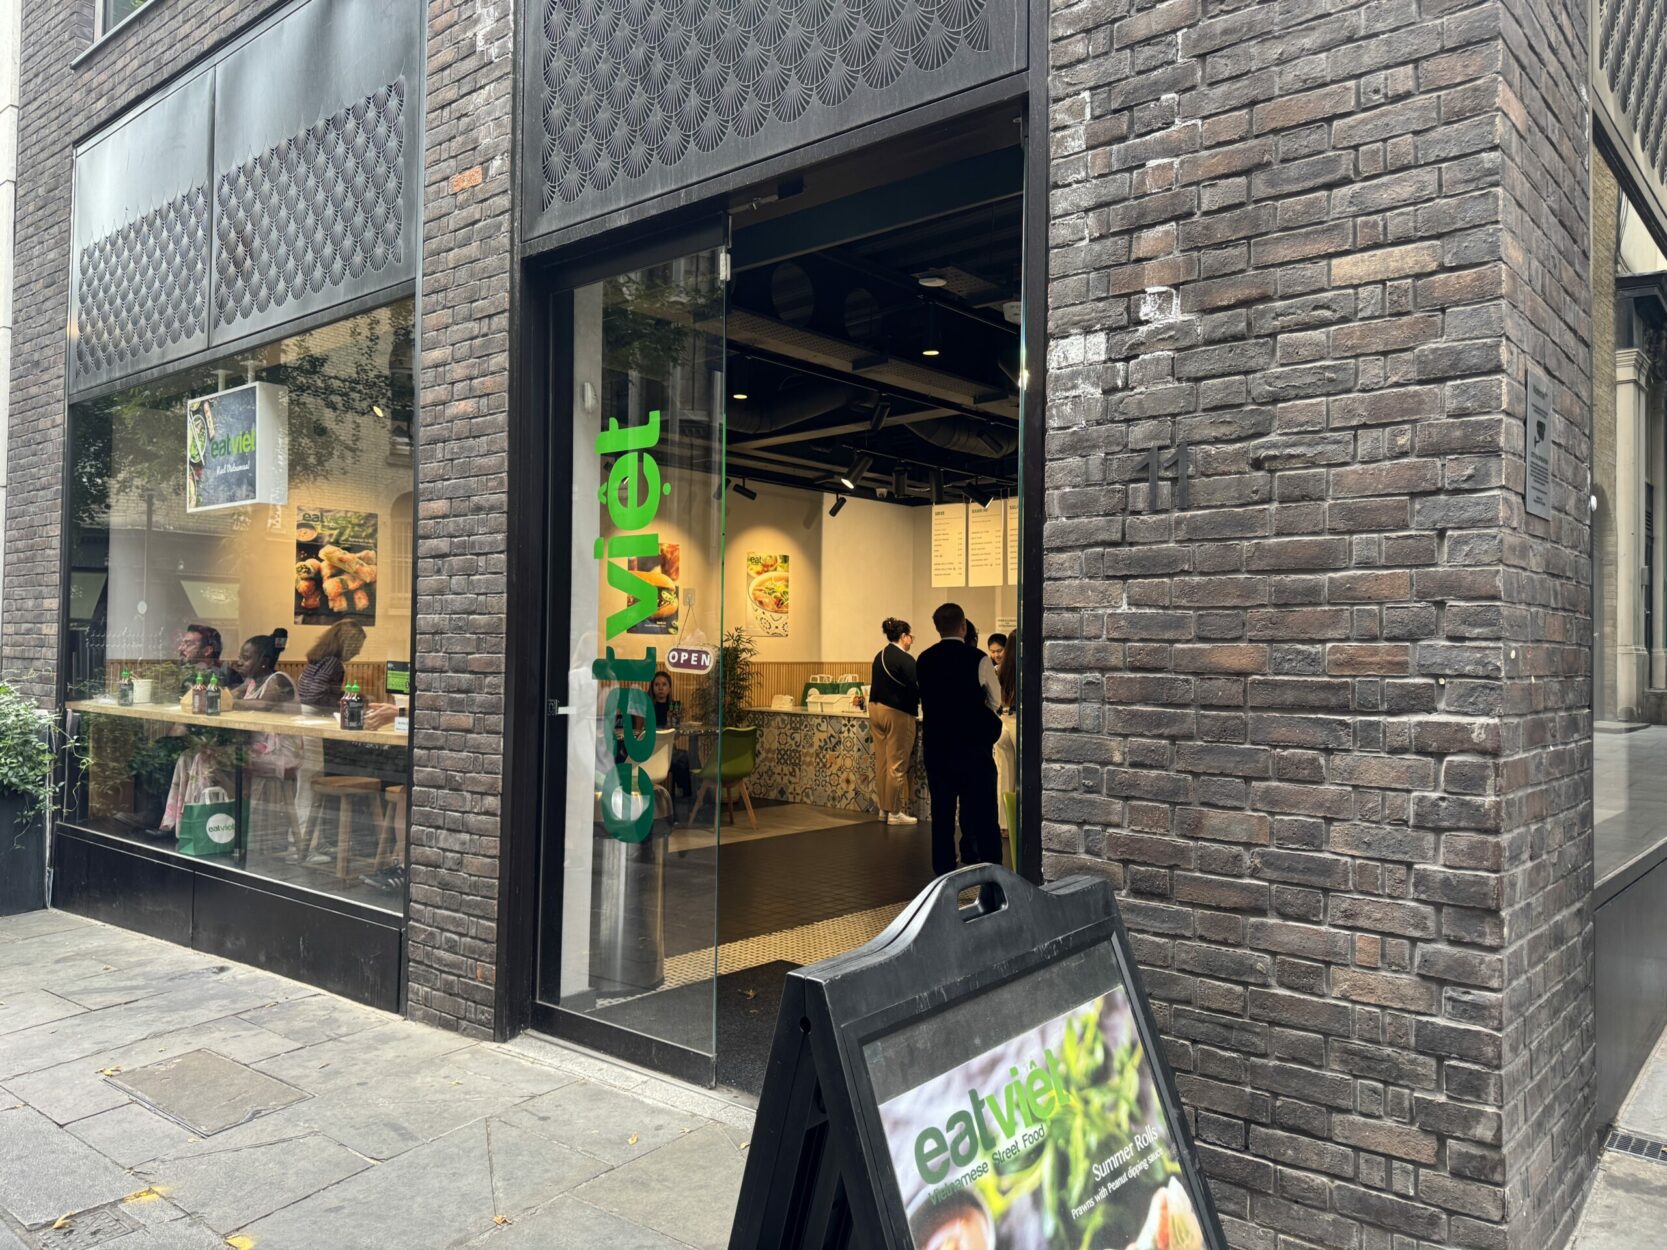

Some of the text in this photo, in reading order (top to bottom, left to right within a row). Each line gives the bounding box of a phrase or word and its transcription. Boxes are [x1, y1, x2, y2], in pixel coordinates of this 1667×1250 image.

[1134, 442, 1188, 511] 11
[669, 651, 710, 666] OPEN
[928, 1124, 1045, 1206] Vietnamese Street Food
[1092, 1124, 1159, 1182] Summer Rolls
[1071, 1198, 1095, 1220] Prawns
[1094, 1186, 1109, 1202] with
[1107, 1171, 1129, 1193] Peanut
[1127, 1159, 1149, 1178] dipping
